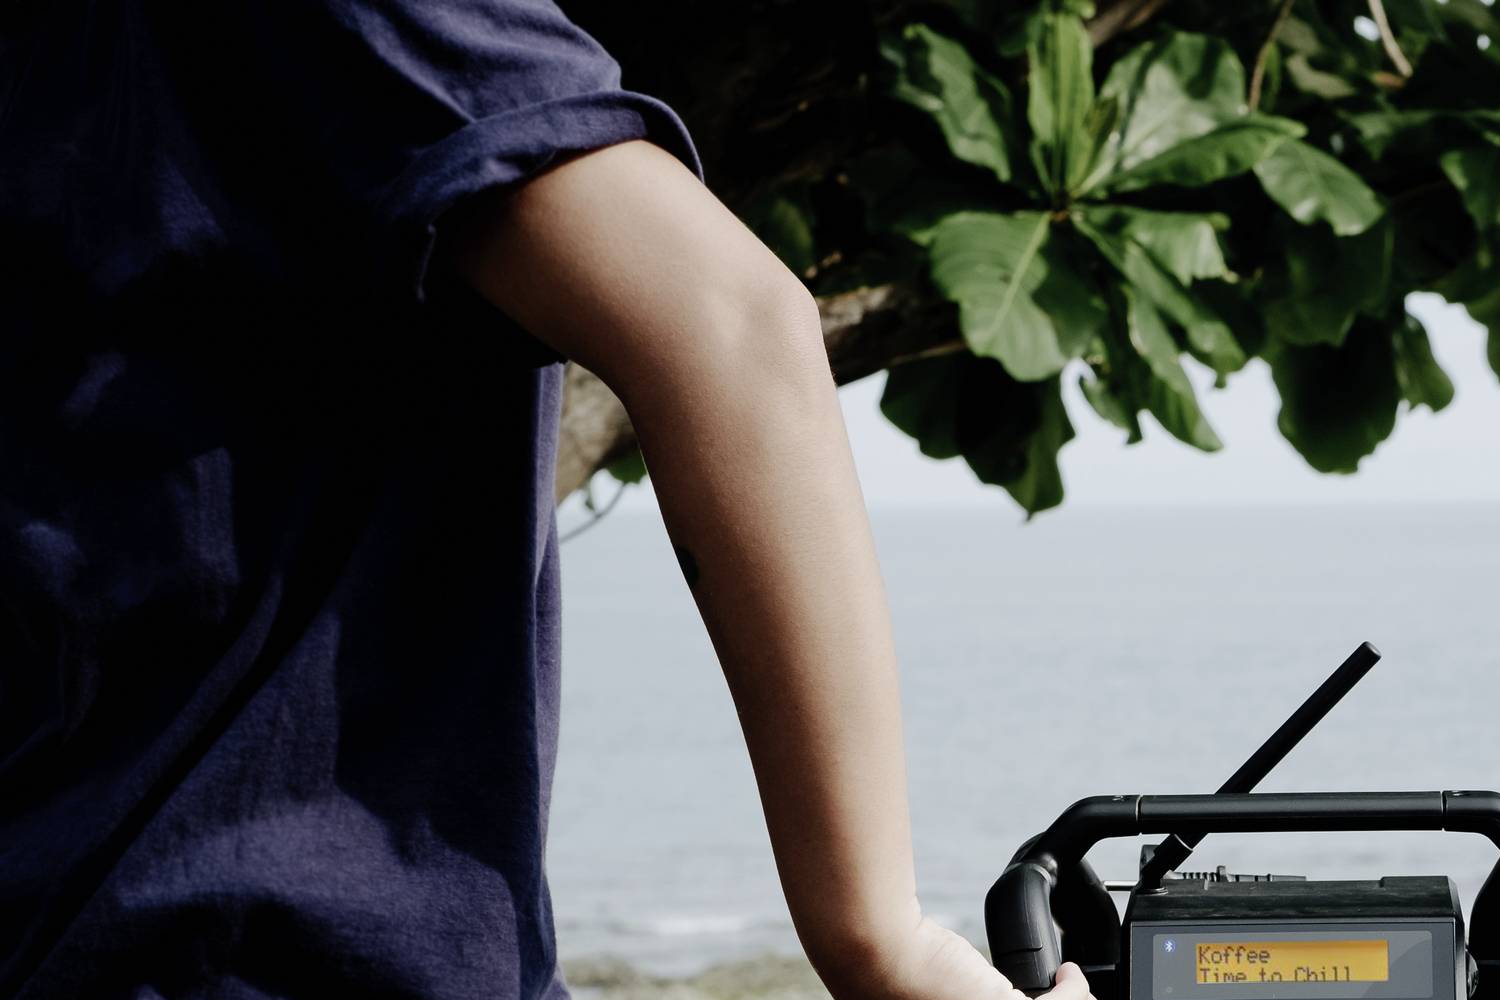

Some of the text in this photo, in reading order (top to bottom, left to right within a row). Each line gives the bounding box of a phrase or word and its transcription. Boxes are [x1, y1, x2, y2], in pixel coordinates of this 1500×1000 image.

[1199, 945, 1271, 965] Koffee
[1200, 966, 1352, 983] Time to Chill
